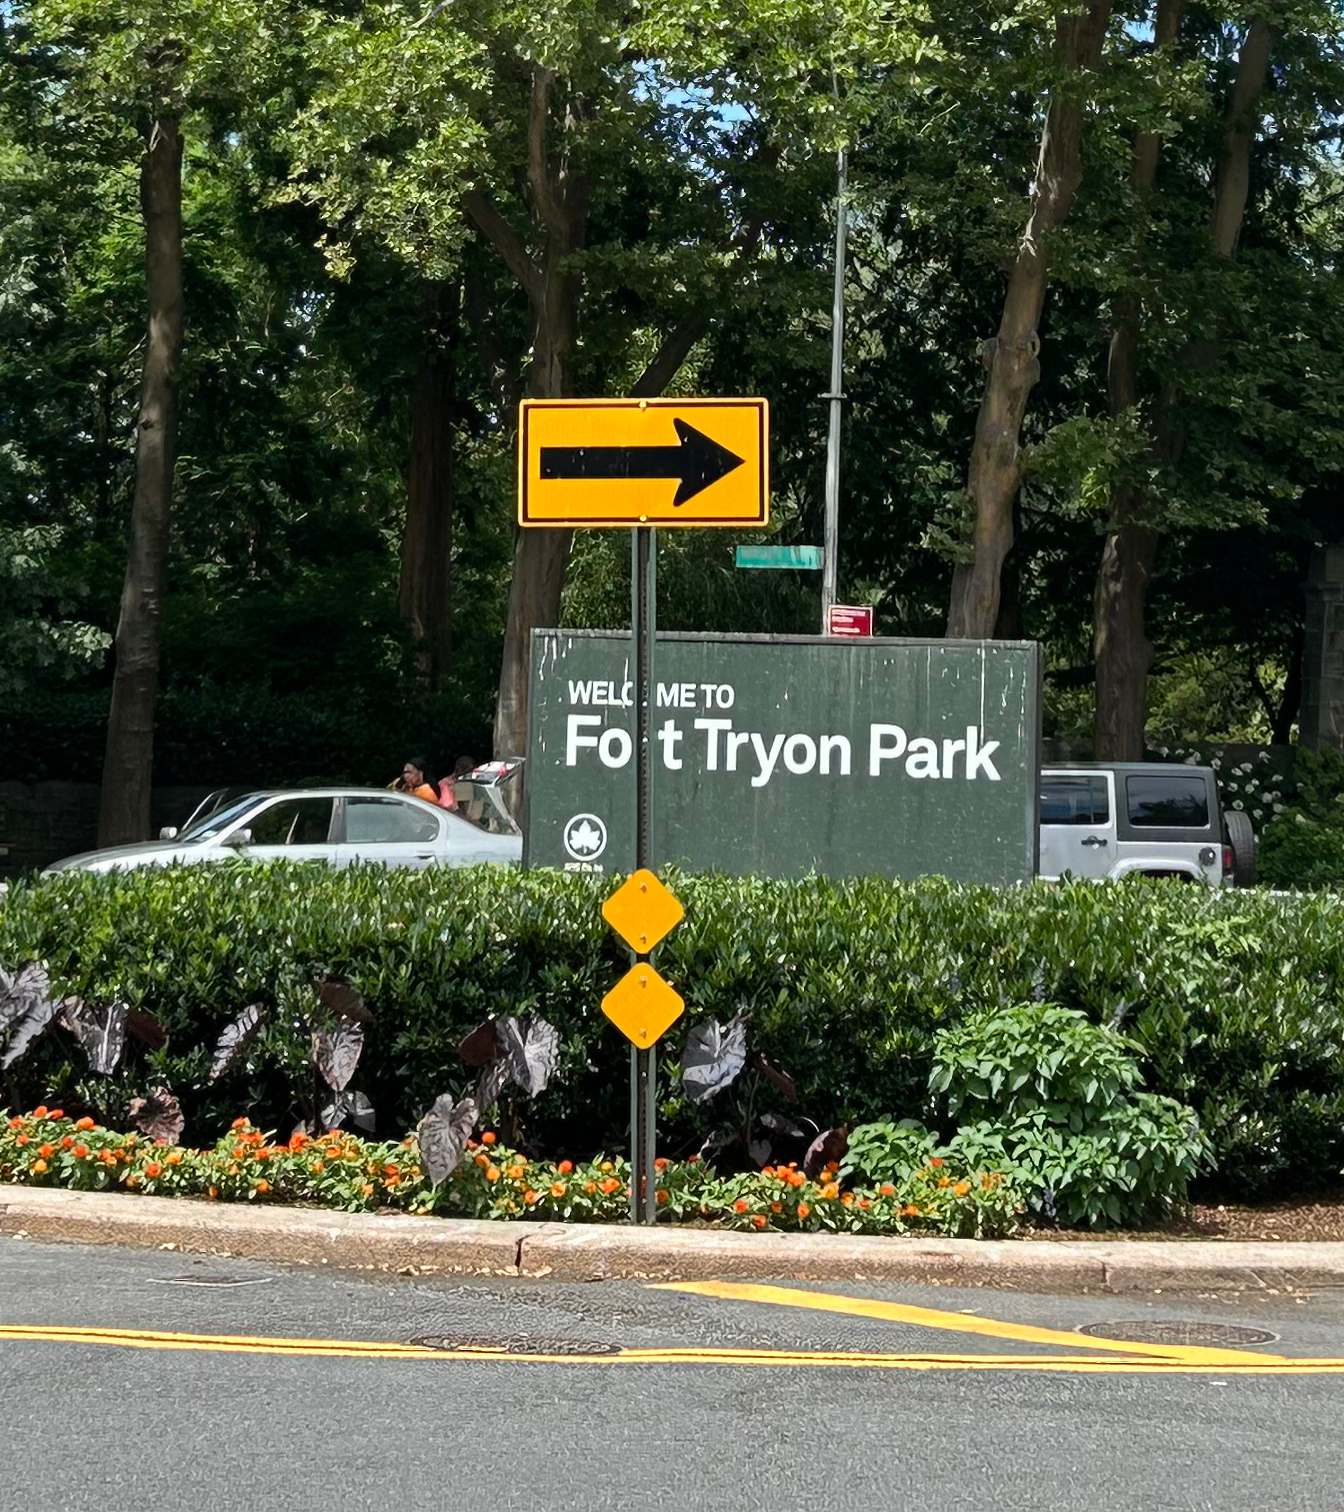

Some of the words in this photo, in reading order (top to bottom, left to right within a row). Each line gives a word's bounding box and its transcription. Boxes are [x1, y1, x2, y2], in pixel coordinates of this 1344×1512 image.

[568, 680, 697, 709] WELCME
[700, 683, 735, 709] TO
[566, 714, 683, 771] Fot
[694, 718, 852, 787] Tryon
[869, 723, 1002, 780] Park
